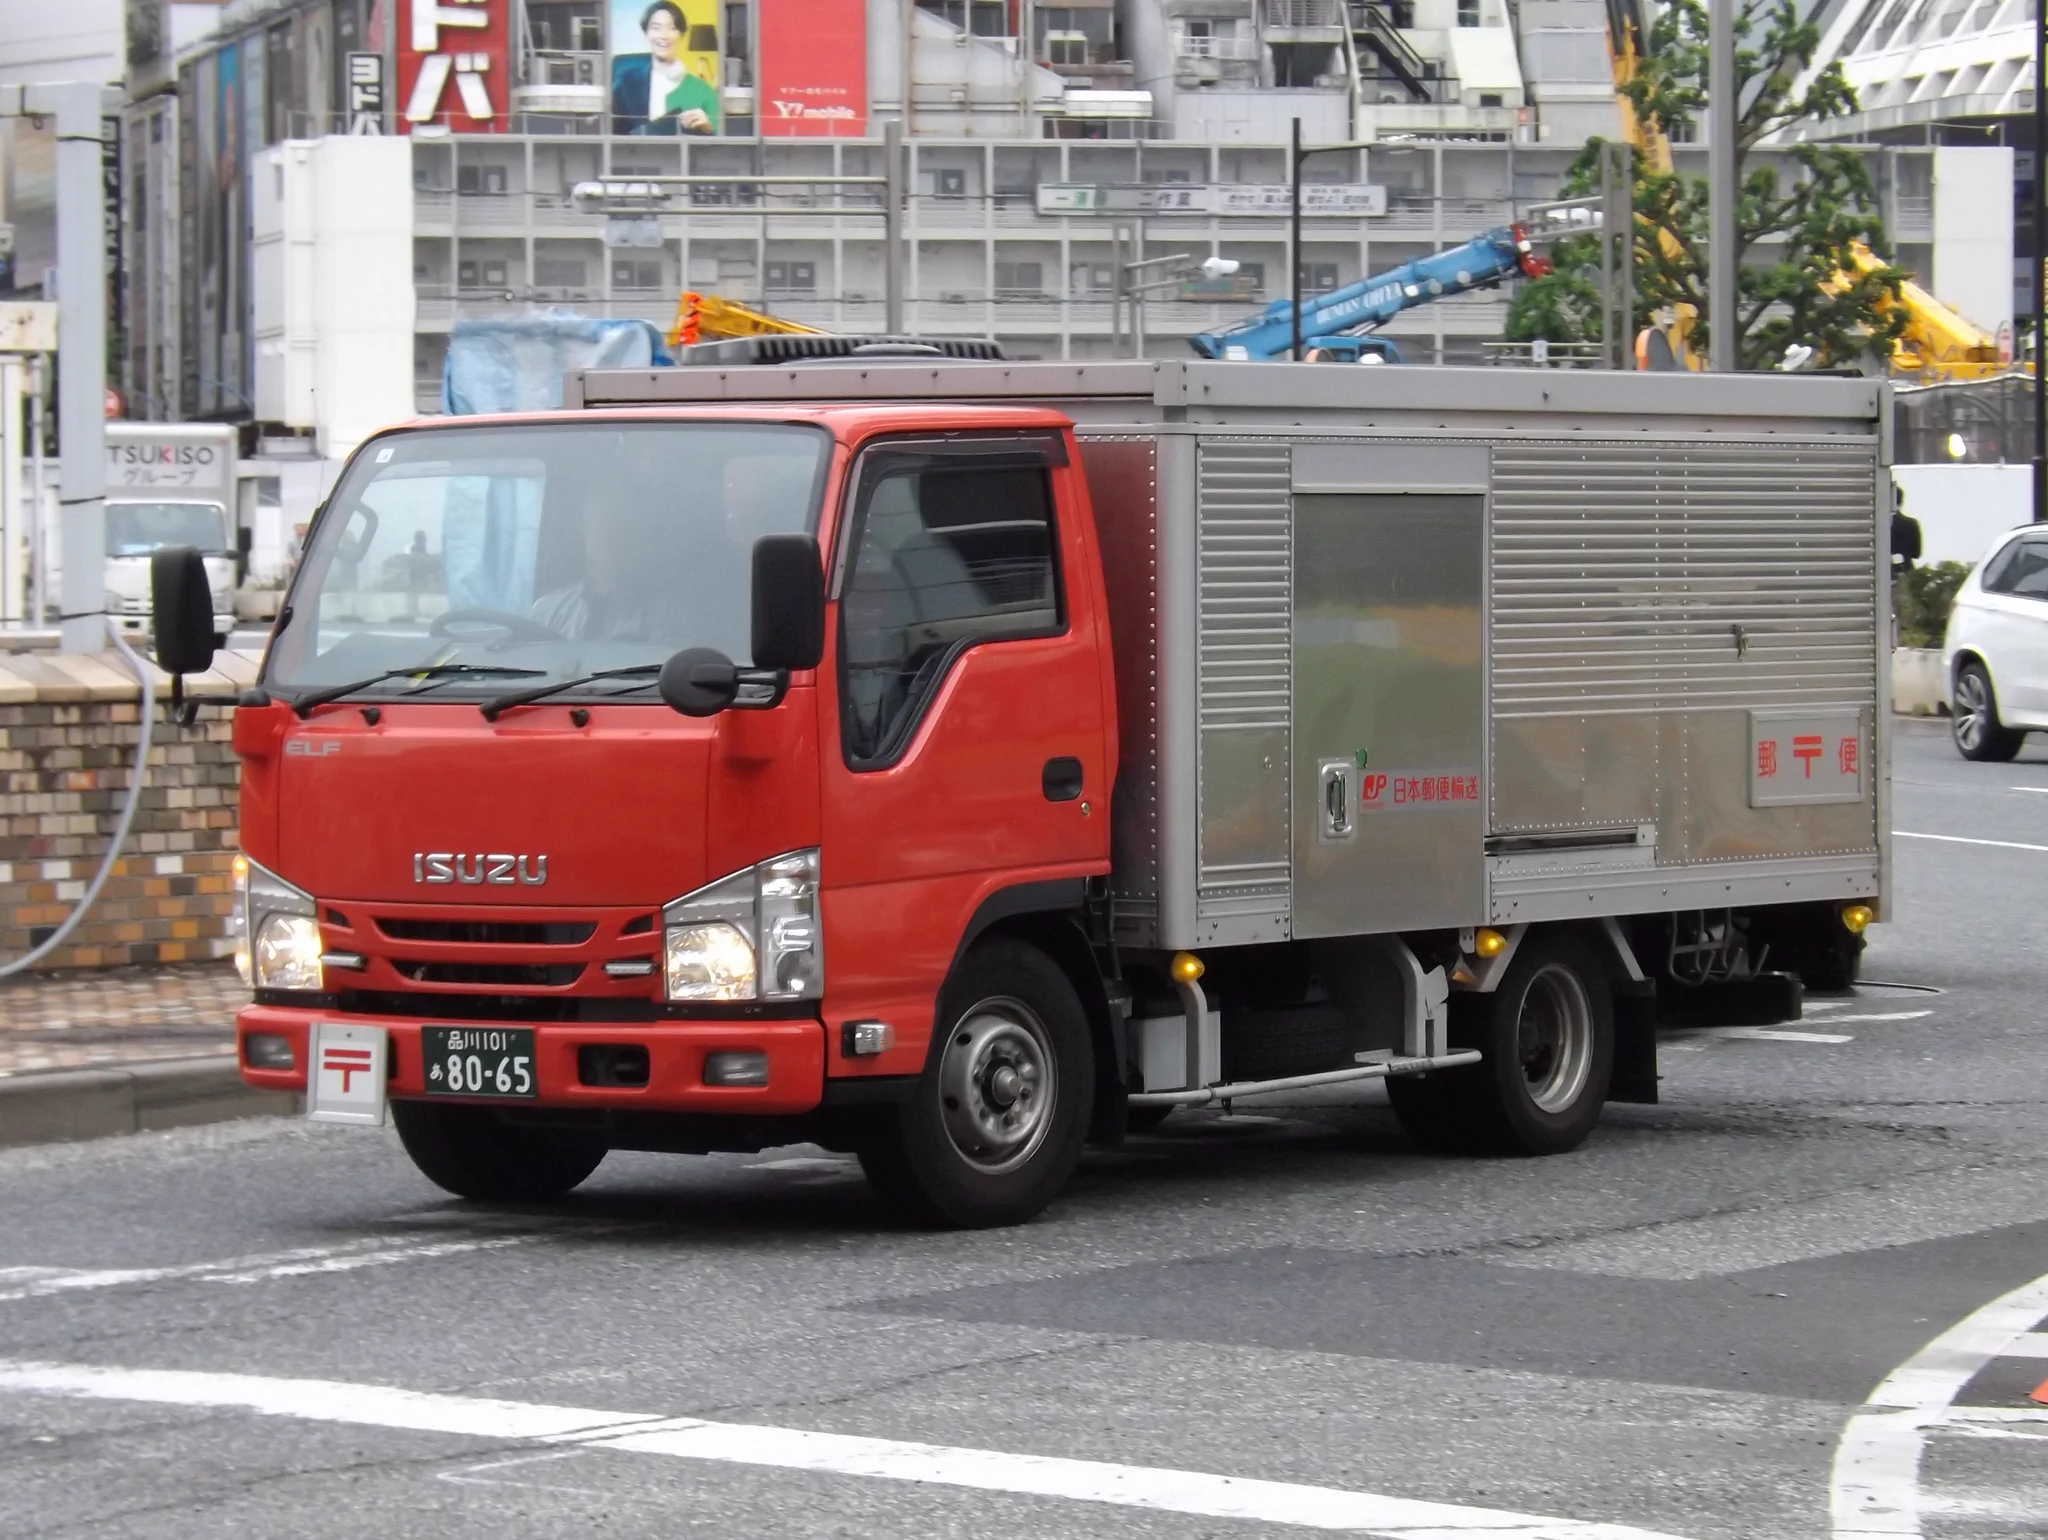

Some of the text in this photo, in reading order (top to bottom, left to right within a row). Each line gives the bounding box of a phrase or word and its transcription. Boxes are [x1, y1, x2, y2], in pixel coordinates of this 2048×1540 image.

[106, 445, 214, 465] TSUKISO
[123, 467, 198, 486] グループ
[285, 741, 341, 756] ELF
[1393, 775, 1479, 804] 日本郵便輸送
[414, 853, 547, 886] ISUZU
[430, 1054, 531, 1093] あ 80-65
